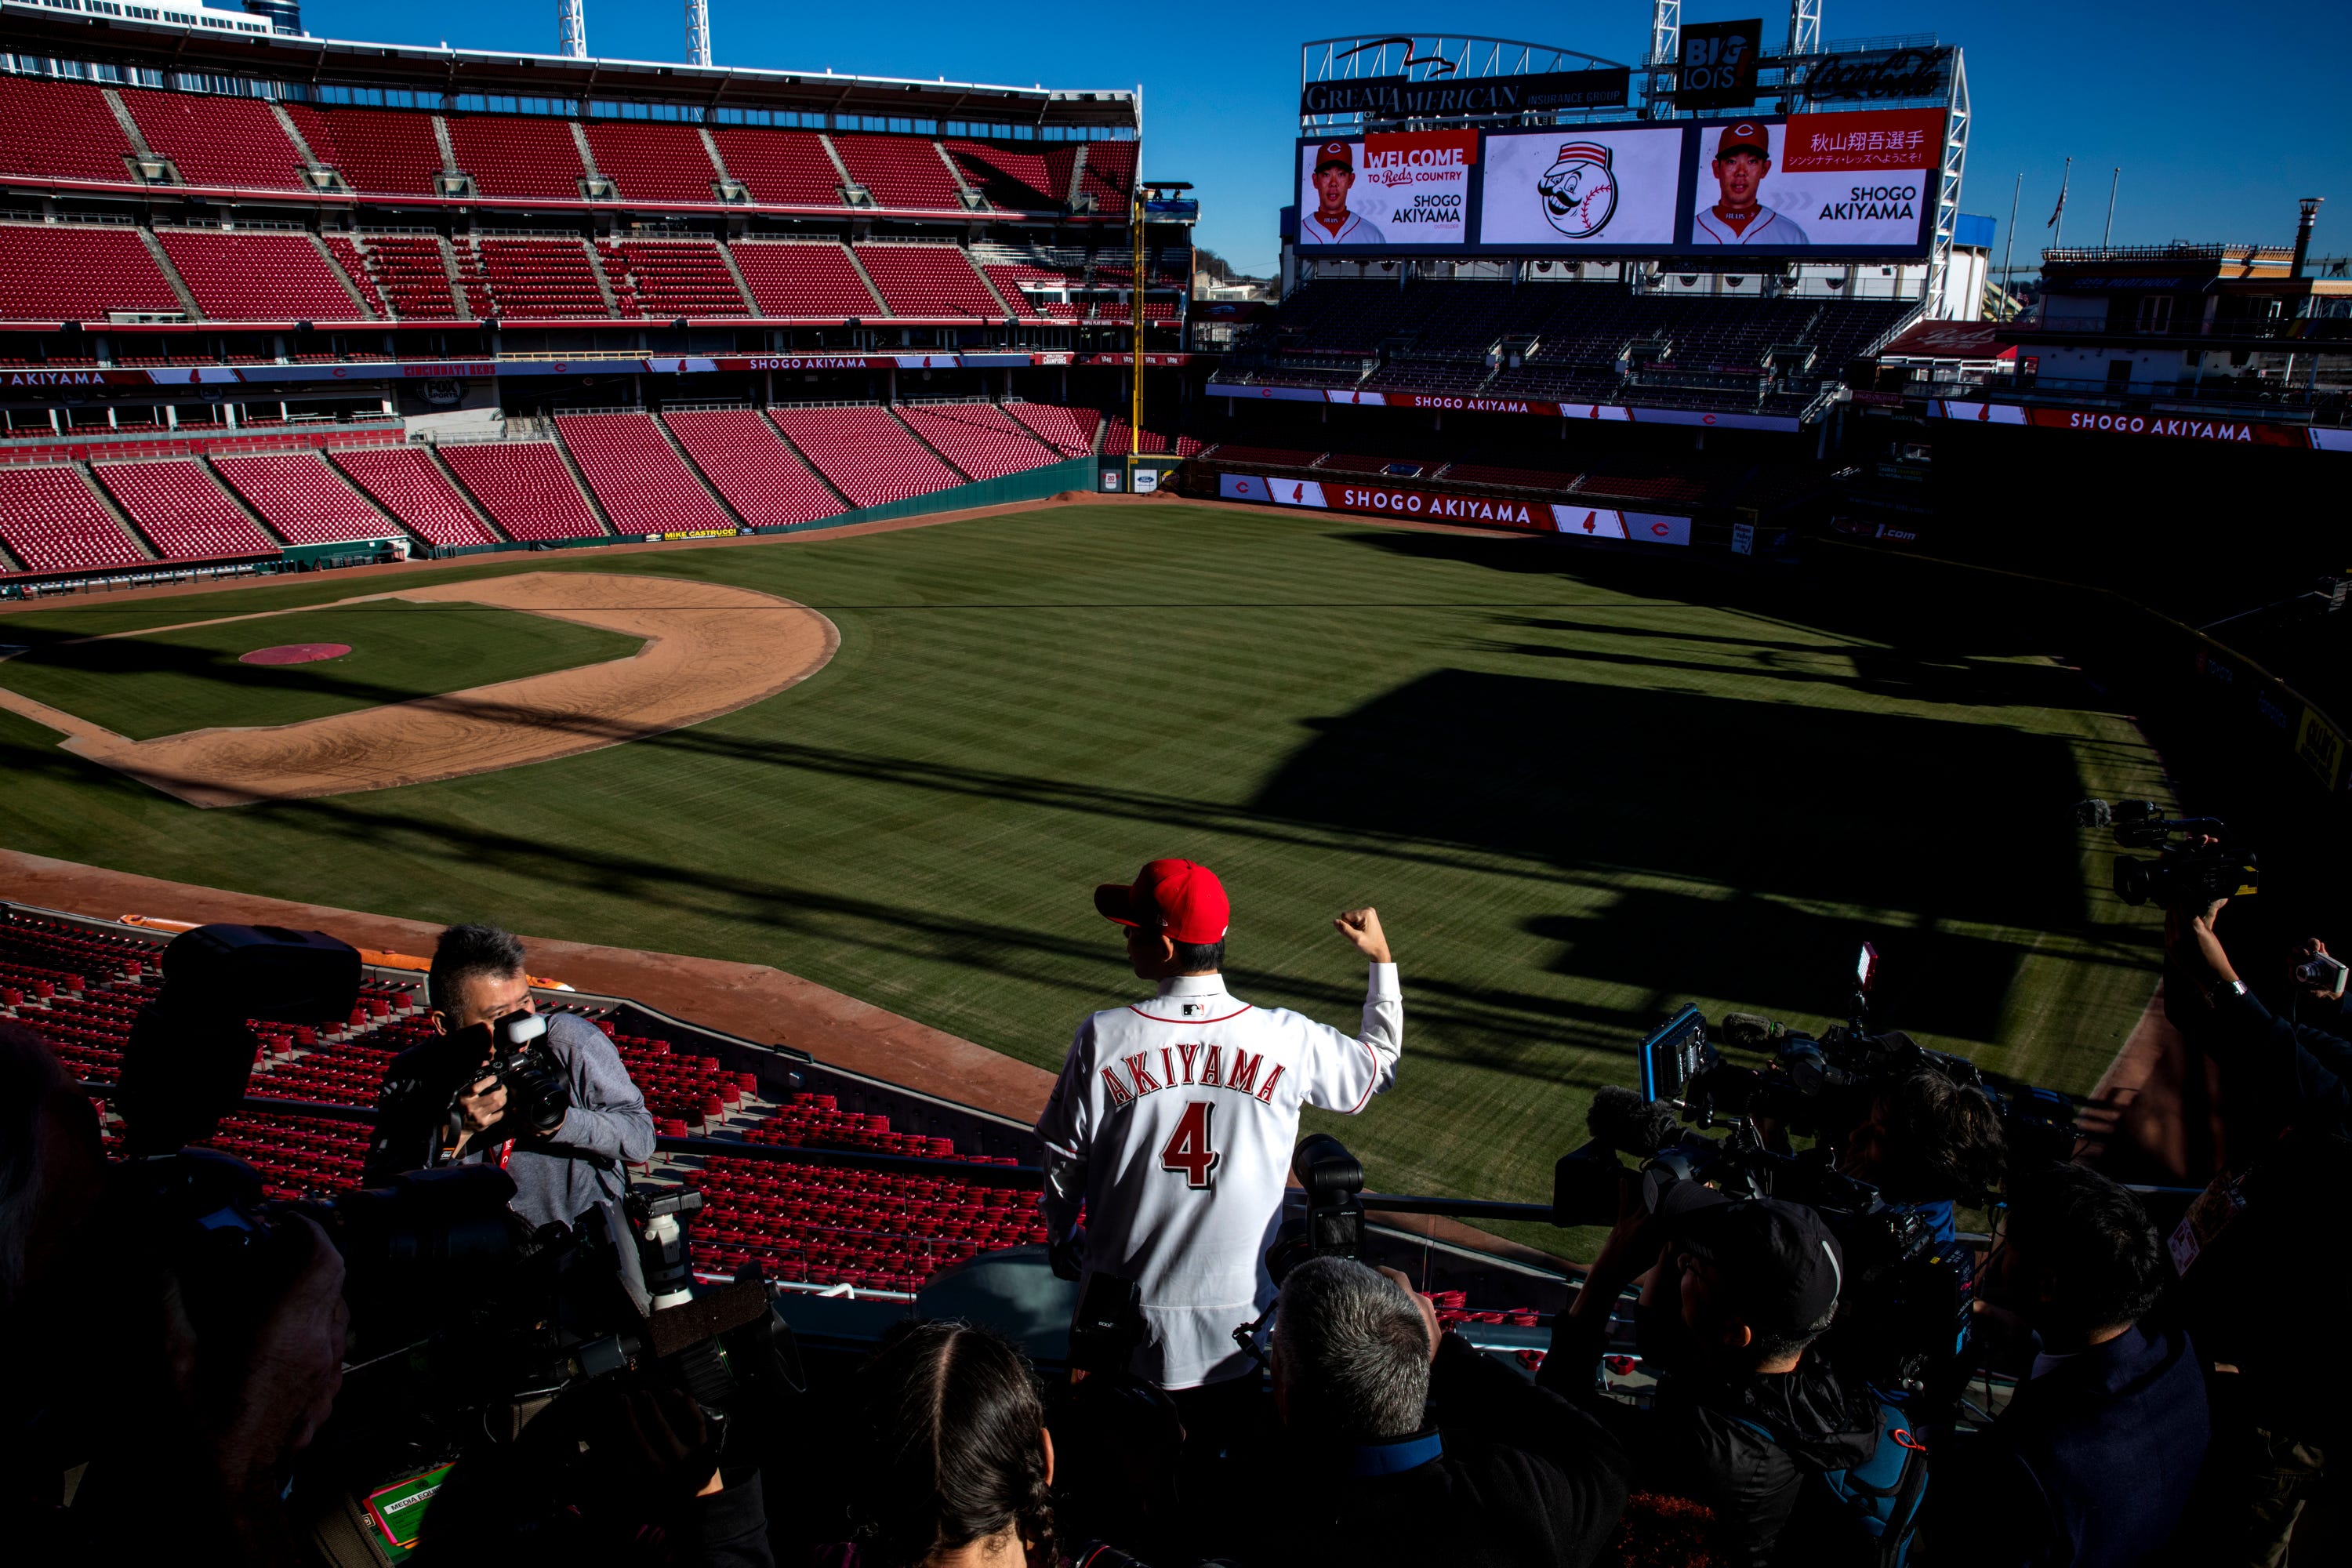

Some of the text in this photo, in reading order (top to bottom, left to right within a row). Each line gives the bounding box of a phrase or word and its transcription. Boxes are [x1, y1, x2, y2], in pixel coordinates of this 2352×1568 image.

[1685, 34, 1748, 67] BIG
[1805, 48, 1952, 101] Coca-Cola
[1306, 85, 1621, 114] GREAT AMERICAN INSURANCE GROUP
[1810, 129, 1924, 152] 秋山翔吾選手
[1367, 148, 1464, 169] WELCOME
[1368, 168, 1462, 188] TO Reds COUNTRY
[1414, 194, 1461, 208] SHOGO
[1850, 186, 1916, 201] SHOGO
[1392, 208, 1461, 223] AKIYAMA
[1819, 201, 1914, 220] AKIYAMA
[1659, 264, 1711, 274] ULTIMATE
[2107, 276, 2141, 288] PILOT
[2140, 276, 2182, 288] HOUSE
[404, 364, 496, 376] CINCINNATI REDS
[750, 358, 867, 369] SHOGO AKIYAMA
[923, 356, 932, 368] 4
[11, 372, 106, 386] AKIYAMA
[428, 379, 457, 392] FOX
[1414, 396, 1529, 413] SHOGO AKIYAMA
[2070, 412, 2252, 442] SHOGO AKIYAMA
[1293, 483, 1304, 503] 4
[1344, 489, 1530, 524] SHOGO AKIYAMA
[1582, 511, 1597, 534] 4
[1099, 1043, 1286, 1106] AKIYAMA
[1158, 1100, 1221, 1190] 4
[390, 1496, 418, 1512] MEDIA
